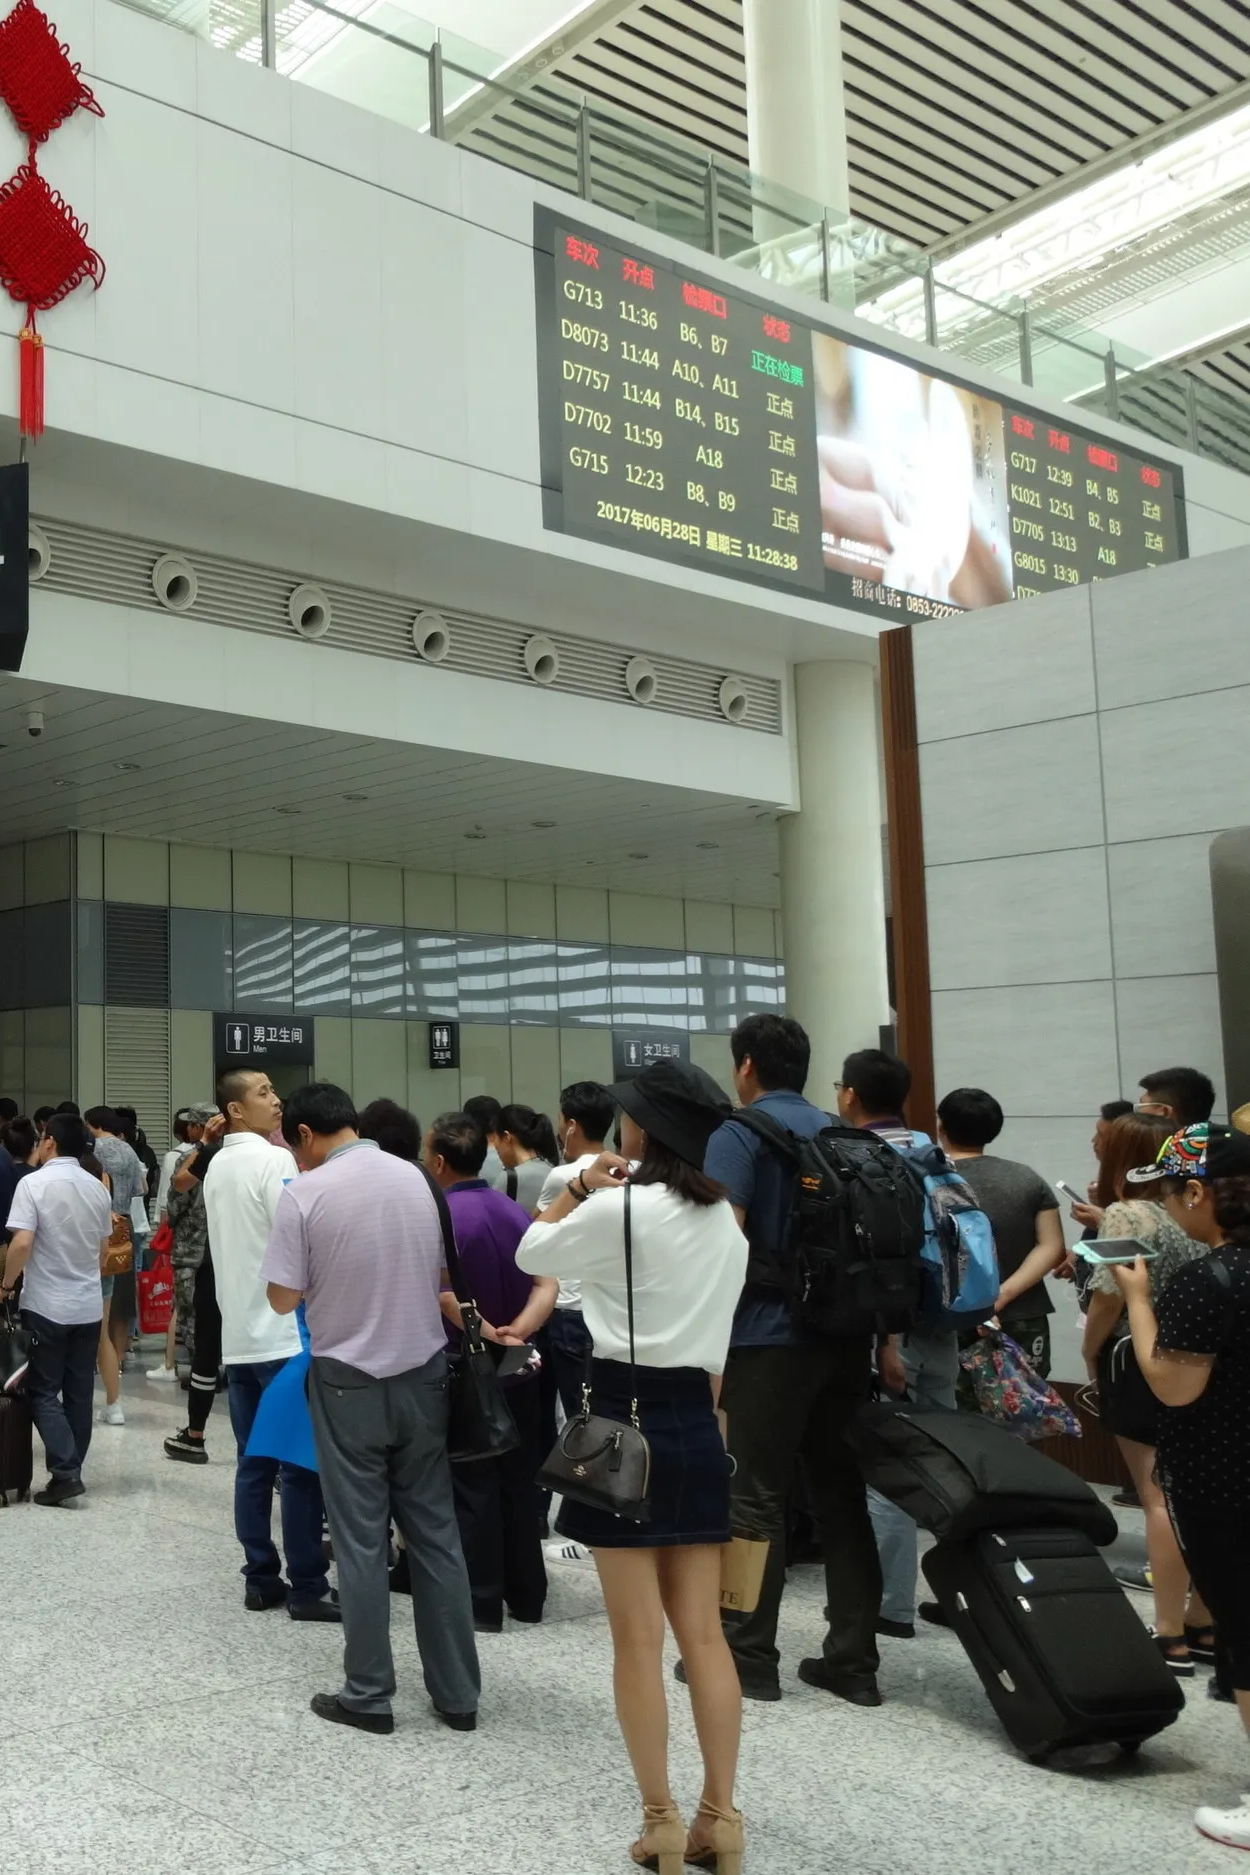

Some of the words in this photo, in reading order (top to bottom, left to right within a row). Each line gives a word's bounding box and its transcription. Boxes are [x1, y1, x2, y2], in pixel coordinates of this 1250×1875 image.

[566, 236, 599, 269] 车次
[622, 258, 654, 290] 开点
[563, 280, 603, 309] G713
[619, 301, 658, 330] 11:36
[751, 349, 805, 387] 正在检票
[561, 319, 609, 352] D8073
[621, 341, 659, 370] 11:44
[766, 392, 794, 419] 正点
[563, 360, 610, 392] D7757
[622, 382, 661, 410] 11:44
[768, 431, 795, 457] 正点
[564, 402, 612, 434] D7702
[624, 422, 663, 449] 11:59
[696, 445, 723, 468] A18
[770, 469, 797, 495] 正点
[569, 447, 609, 474] G715
[625, 464, 665, 491] 12:23
[772, 508, 799, 534] 正点
[1011, 452, 1036, 474] G717
[1047, 465, 1072, 487] 12:39
[1142, 500, 1161, 522] 正点
[1011, 483, 1042, 509] K1021
[1049, 498, 1074, 520] 12:51
[1144, 531, 1163, 552] 正点
[597, 500, 701, 547] 2017年06月28日
[705, 530, 743, 558] 星期三
[747, 543, 798, 571] 11:28:38
[1012, 517, 1044, 541] D7705
[1051, 531, 1077, 553] 13:13
[1098, 546, 1116, 565] A18
[1014, 551, 1046, 575] G8015
[1053, 564, 1079, 585] 13:30
[253, 1026, 303, 1044] 男卫生间
[253, 1045, 267, 1053] Men
[644, 1043, 680, 1058] 女卫生间
